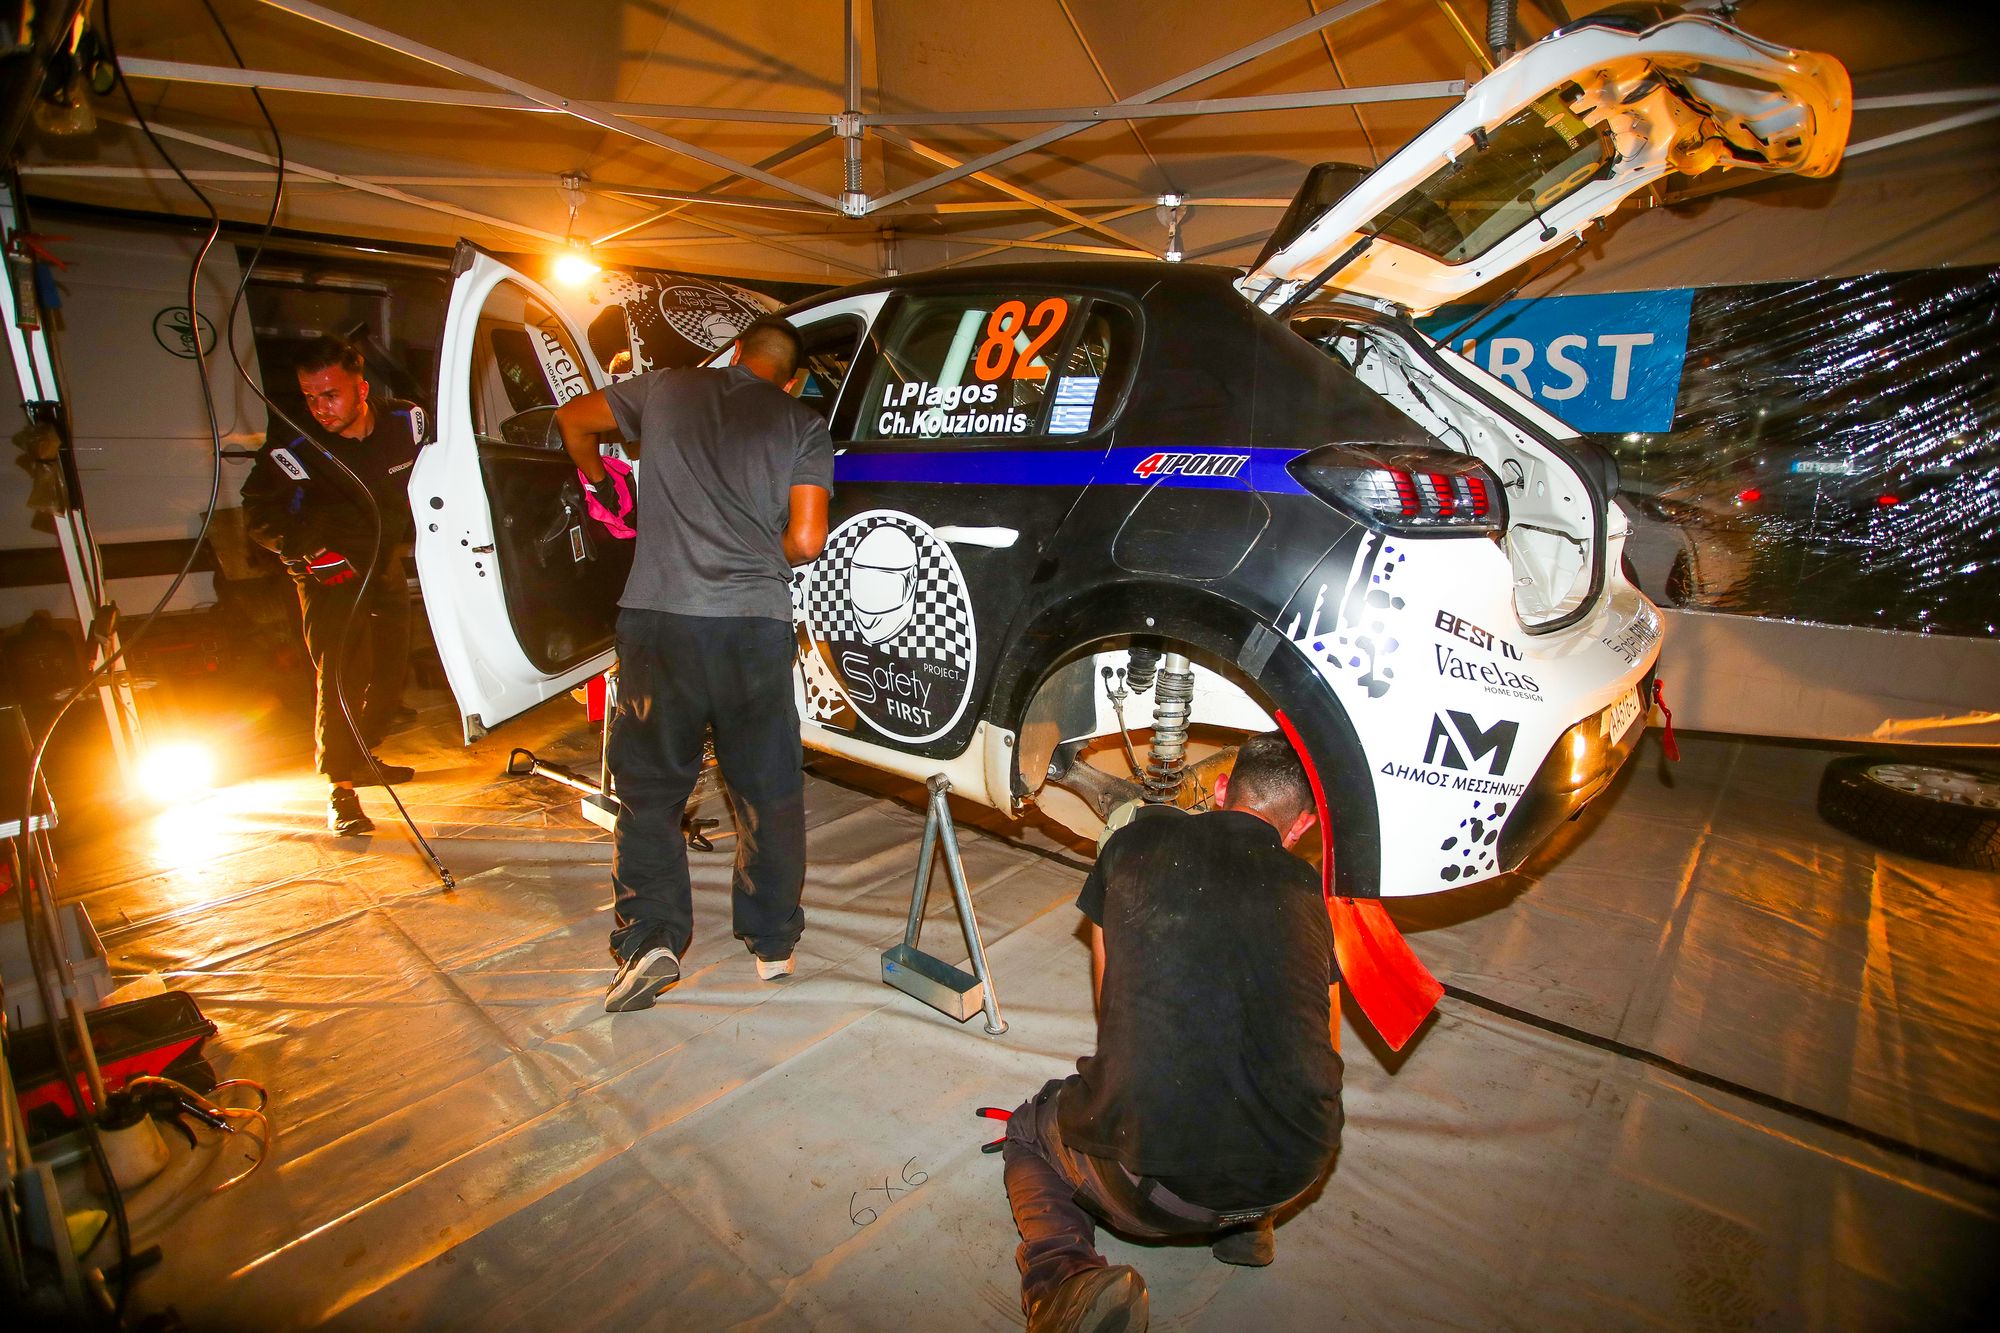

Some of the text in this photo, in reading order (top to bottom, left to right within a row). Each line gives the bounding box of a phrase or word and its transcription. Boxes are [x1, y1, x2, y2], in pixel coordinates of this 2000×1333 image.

[974, 297, 1069, 382] 82
[1445, 332, 1655, 401] RST
[882, 381, 999, 411] I.Plagos
[878, 407, 1028, 435] Ch.Kouzionis
[1434, 609, 1495, 652] BEST
[841, 650, 932, 708] Safety
[923, 662, 961, 681] PROJECT
[1434, 643, 1540, 693] Varelas
[1484, 685, 1544, 703] HOME DESIGN
[886, 697, 932, 728] FIRST
[1380, 761, 1525, 797] ΔΗΜΟΣ ΜΕΣΣΗΝΗΣ
